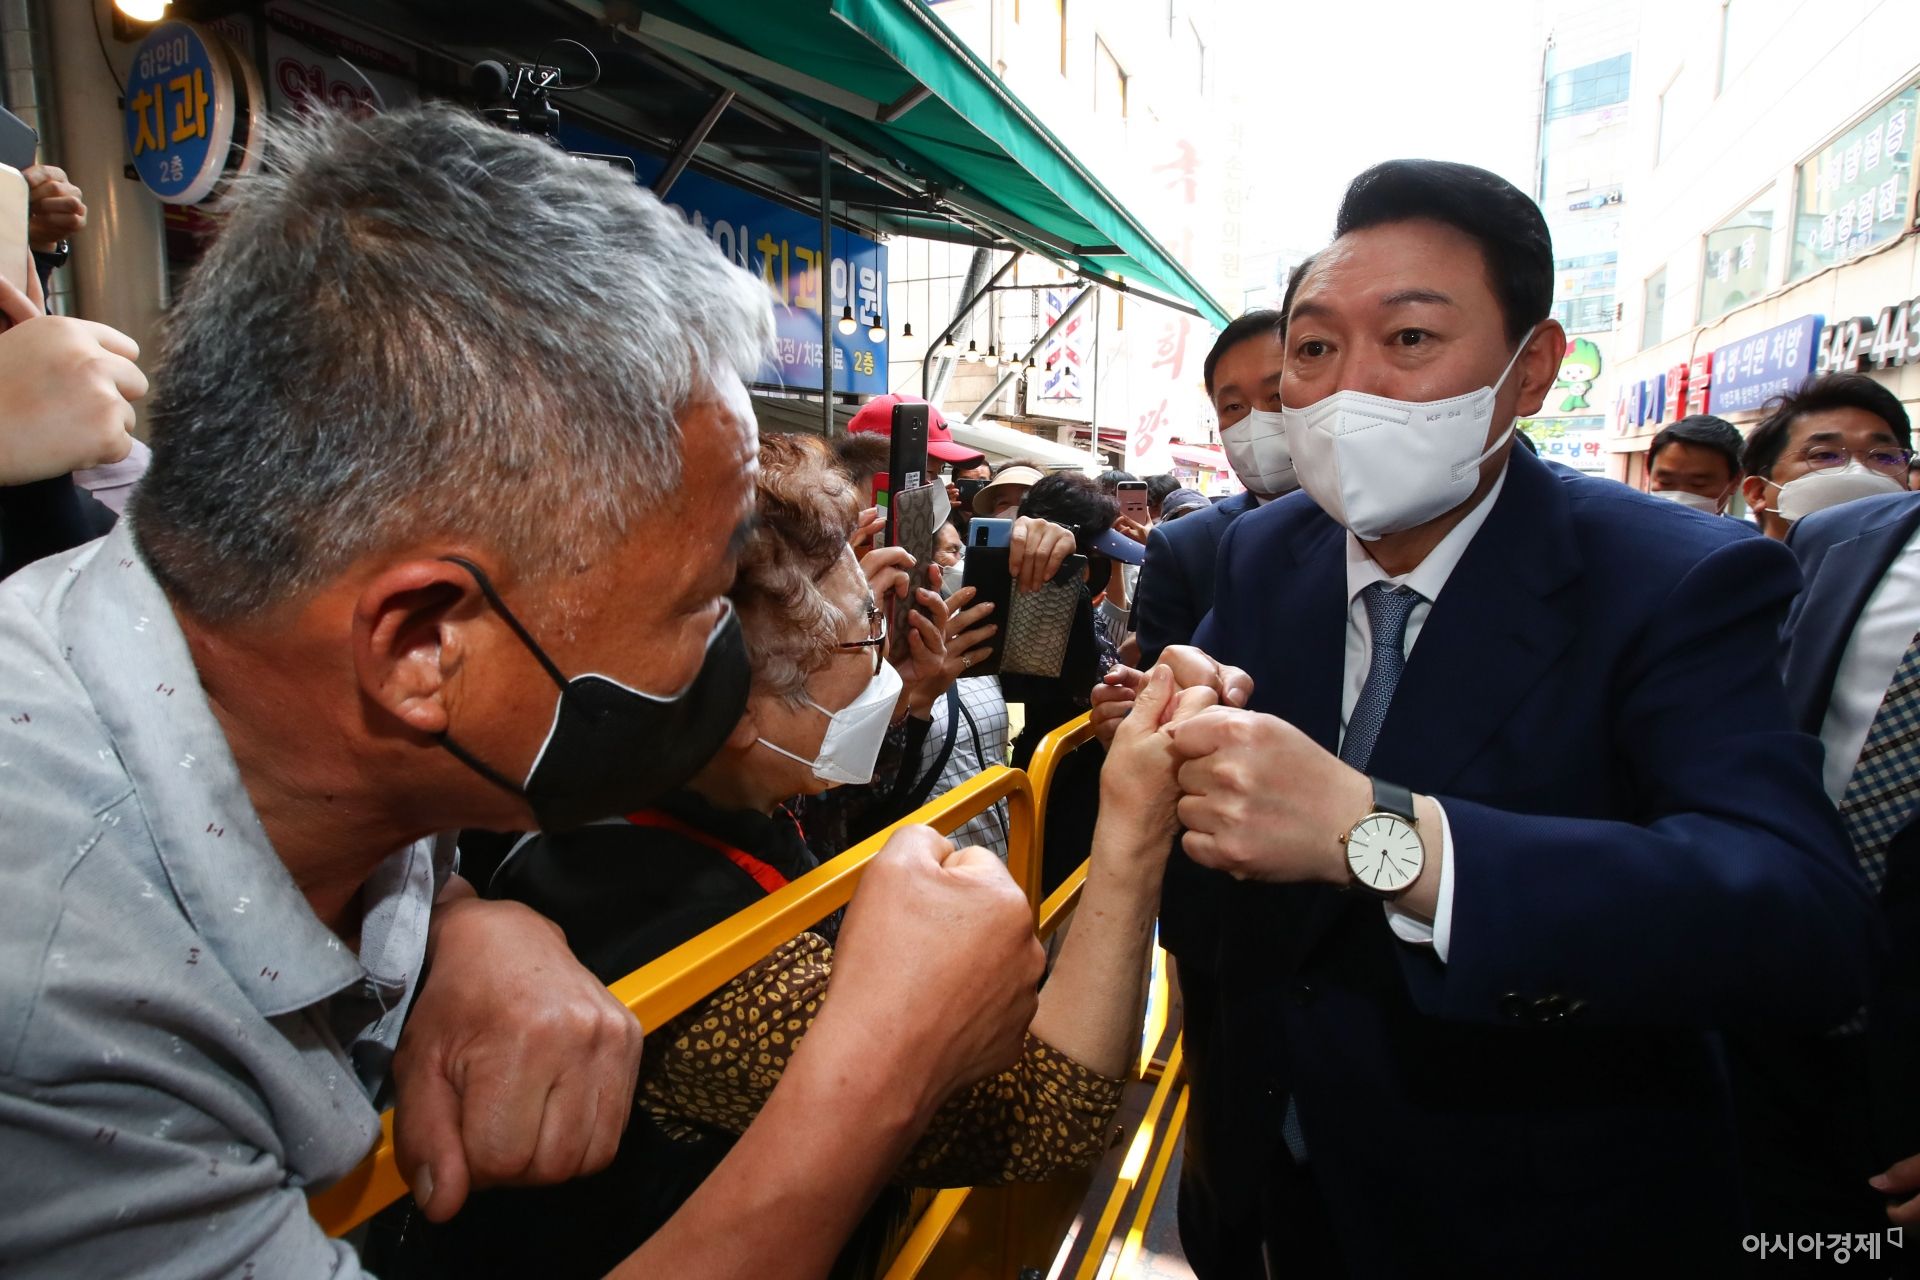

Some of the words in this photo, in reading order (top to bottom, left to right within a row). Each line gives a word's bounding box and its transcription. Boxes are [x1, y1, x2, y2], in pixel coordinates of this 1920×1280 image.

[140, 35, 189, 80] 하얀이
[132, 68, 209, 156] 치과
[159, 155, 184, 183] 2층
[1821, 174, 1899, 250] 건강검진
[854, 351, 874, 376] 2층
[1770, 324, 1803, 369] 처방
[1426, 414, 1441, 422] KF
[1447, 410, 1461, 419] 94
